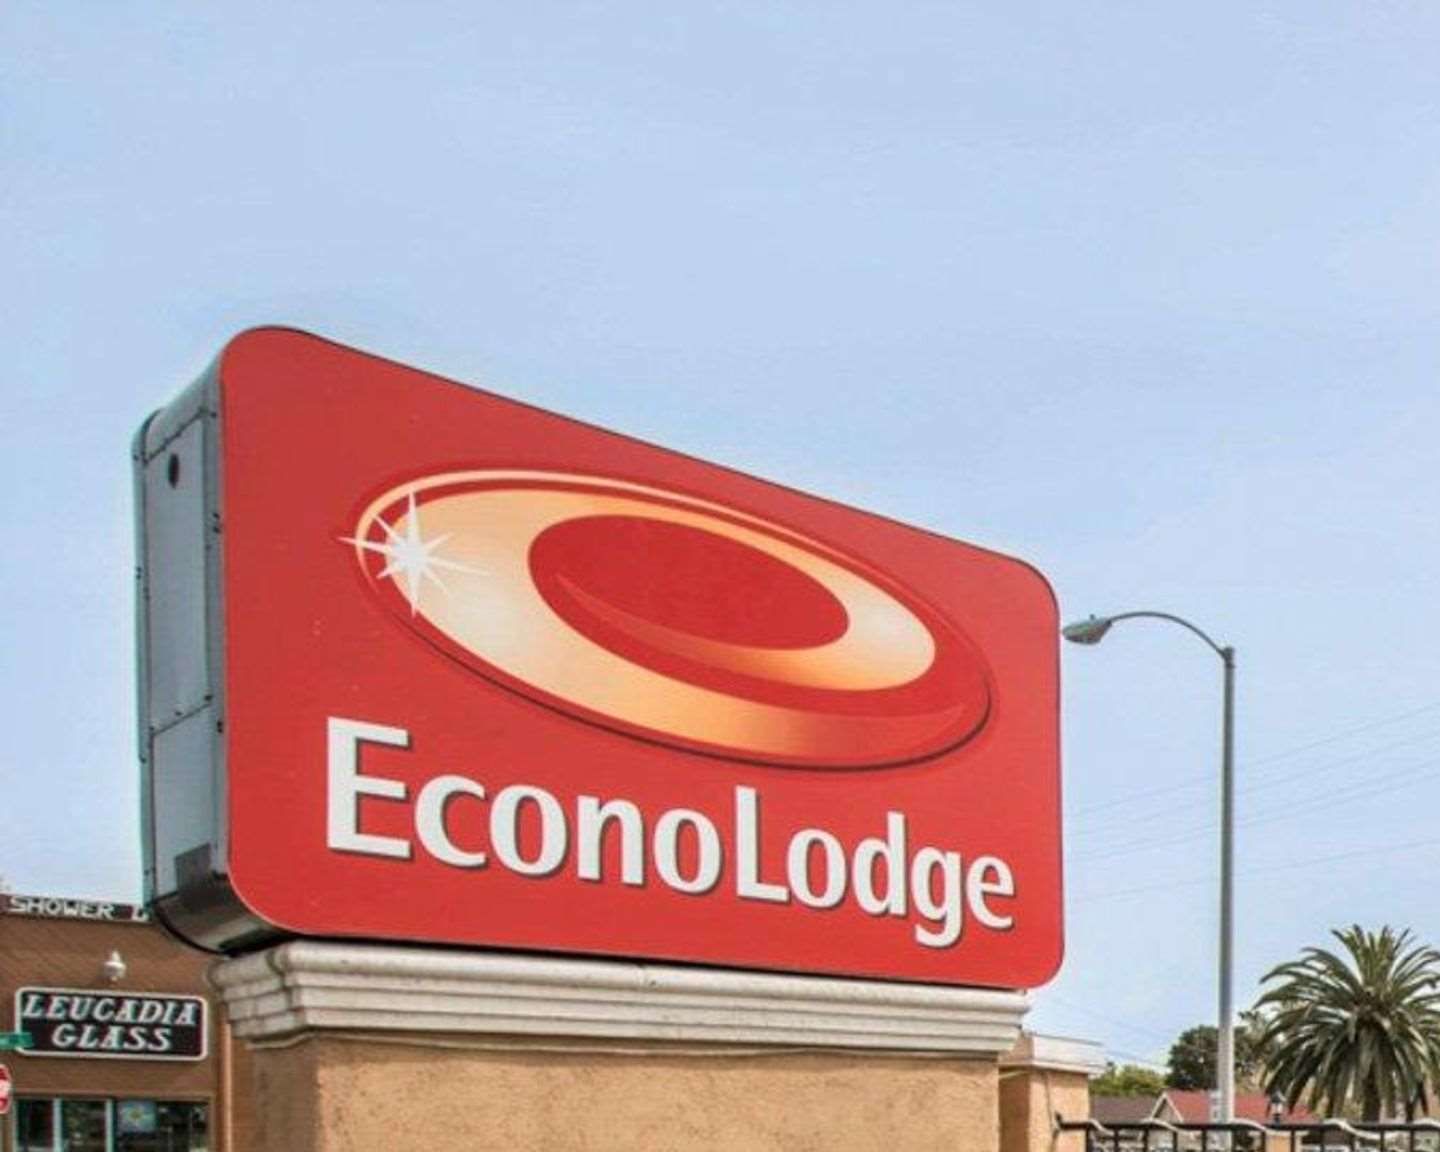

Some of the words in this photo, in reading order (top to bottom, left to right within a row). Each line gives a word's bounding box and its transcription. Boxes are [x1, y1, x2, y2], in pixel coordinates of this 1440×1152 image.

[327, 716, 1015, 948] EconoLodge
[8, 896, 115, 920] SHOWER
[23, 994, 198, 1026] LEUCADIA
[51, 1023, 173, 1052] GLASS
